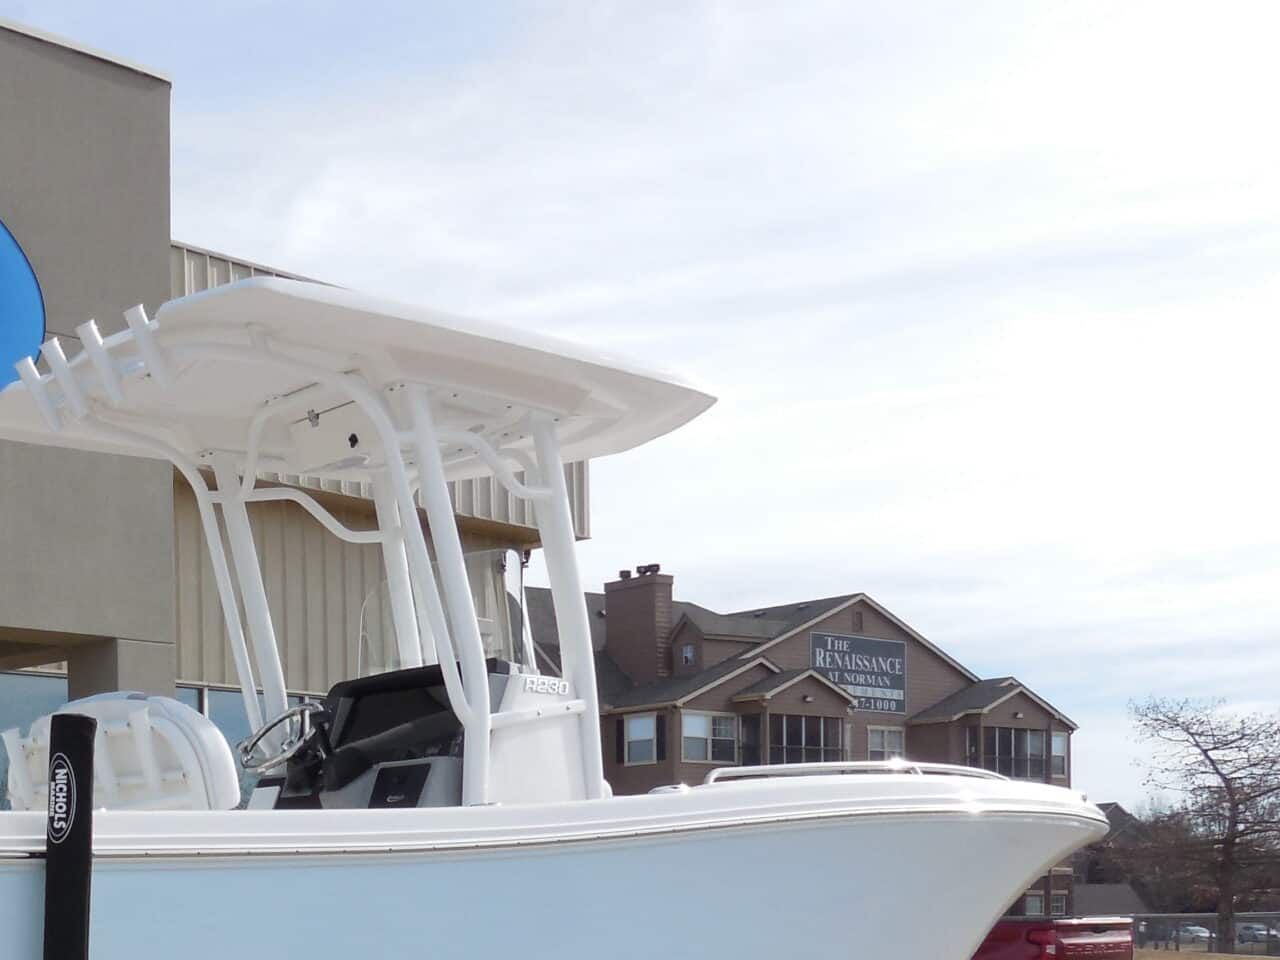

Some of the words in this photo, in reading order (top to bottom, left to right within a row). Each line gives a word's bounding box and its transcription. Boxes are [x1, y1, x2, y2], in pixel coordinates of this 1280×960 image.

[824, 636, 850, 652] THE
[815, 647, 903, 675] RENAISSANCE
[526, 677, 569, 695] R230
[828, 671, 841, 683] AT
[844, 672, 891, 687] NORMAN
[53, 768, 68, 829] NICHOLS
